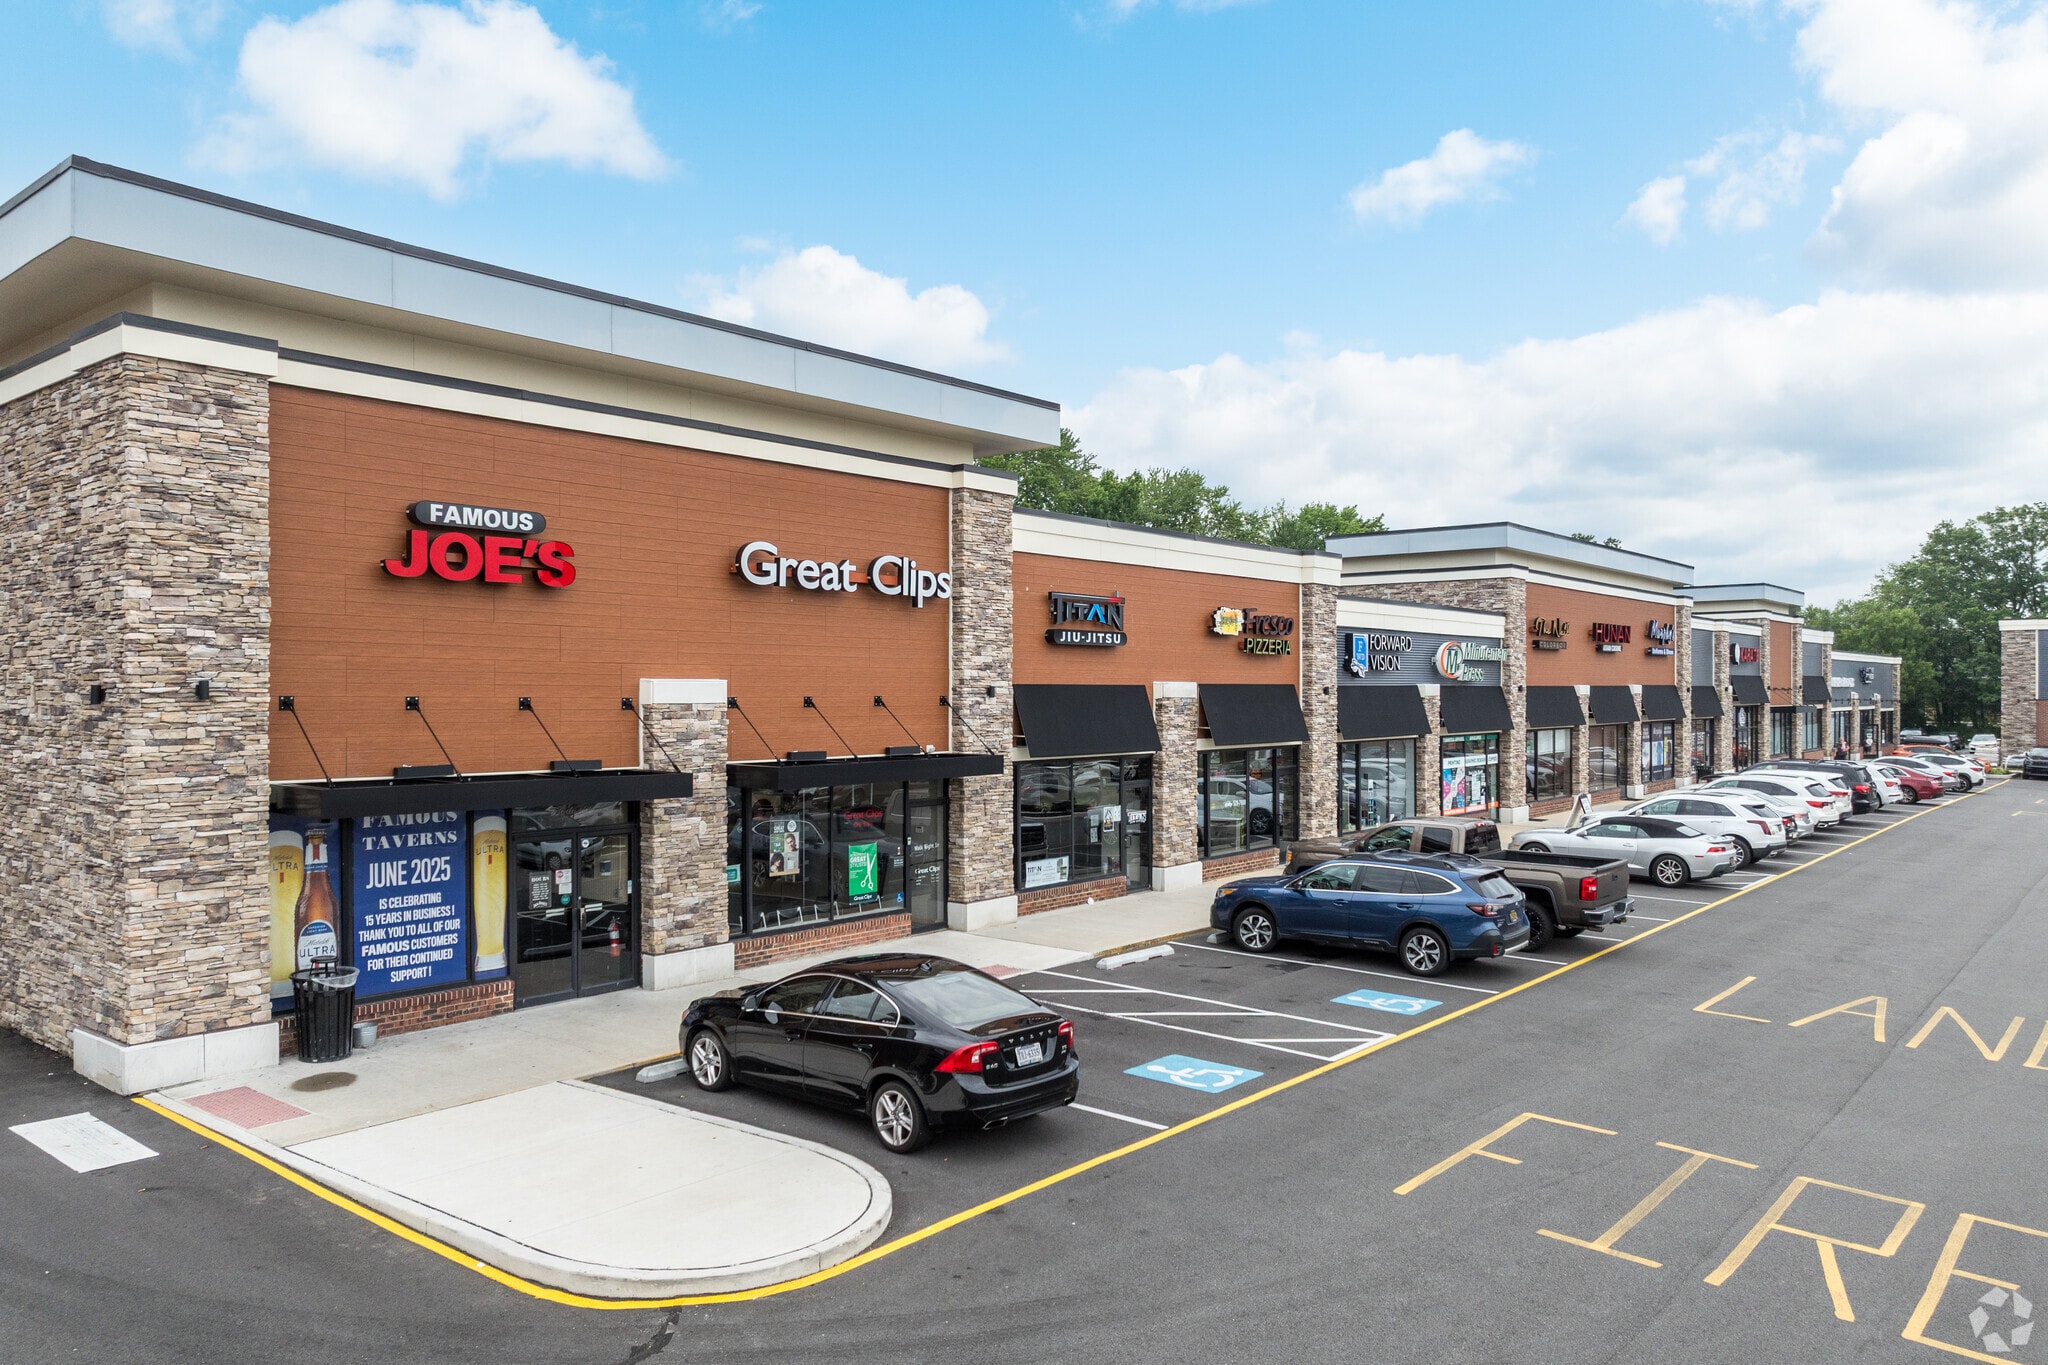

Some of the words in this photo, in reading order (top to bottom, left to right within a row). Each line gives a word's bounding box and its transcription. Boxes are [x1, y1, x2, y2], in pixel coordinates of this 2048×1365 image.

[430, 503, 534, 531] FAMOUS
[384, 529, 577, 588] JOE'S
[740, 540, 858, 593] Great
[872, 554, 950, 609] Clips
[1049, 591, 1126, 632] TITAN
[1243, 607, 1295, 636] Fresco
[1370, 634, 1413, 652] FORWARD
[1595, 622, 1631, 643] HUNAN
[1246, 638, 1292, 656] PIZZERIA
[1370, 654, 1401, 671] VISION
[1460, 663, 1484, 681] Press
[362, 811, 458, 829] FAMOUS
[362, 830, 458, 851] TAVERNS
[475, 844, 505, 856] ULTRA
[272, 861, 299, 871] LTRA
[366, 860, 408, 889] JUNE
[411, 856, 451, 884] 2025
[379, 898, 388, 910] IS
[388, 892, 442, 909] CELEBRATING
[364, 914, 374, 927] 15
[375, 911, 403, 925] YEARS
[403, 910, 412, 922] IN
[412, 905, 451, 921] BUSINESS
[358, 927, 387, 942] THANK
[388, 925, 405, 939] YOU
[406, 923, 417, 936] TO
[417, 922, 433, 935] ALL
[433, 920, 444, 932] OF
[444, 918, 461, 930] OUR
[299, 944, 337, 958] ULTRA
[361, 940, 410, 957] FAMOUS
[410, 933, 459, 950] CUSTOMERS
[367, 958, 384, 971] FOR
[385, 954, 409, 969] THEIR
[409, 948, 454, 965] CONTINUED
[390, 966, 428, 983] SUPPORT
[1008, 1028, 1052, 1044] VOLVO
[1393, 1112, 2048, 1365] FIRE
